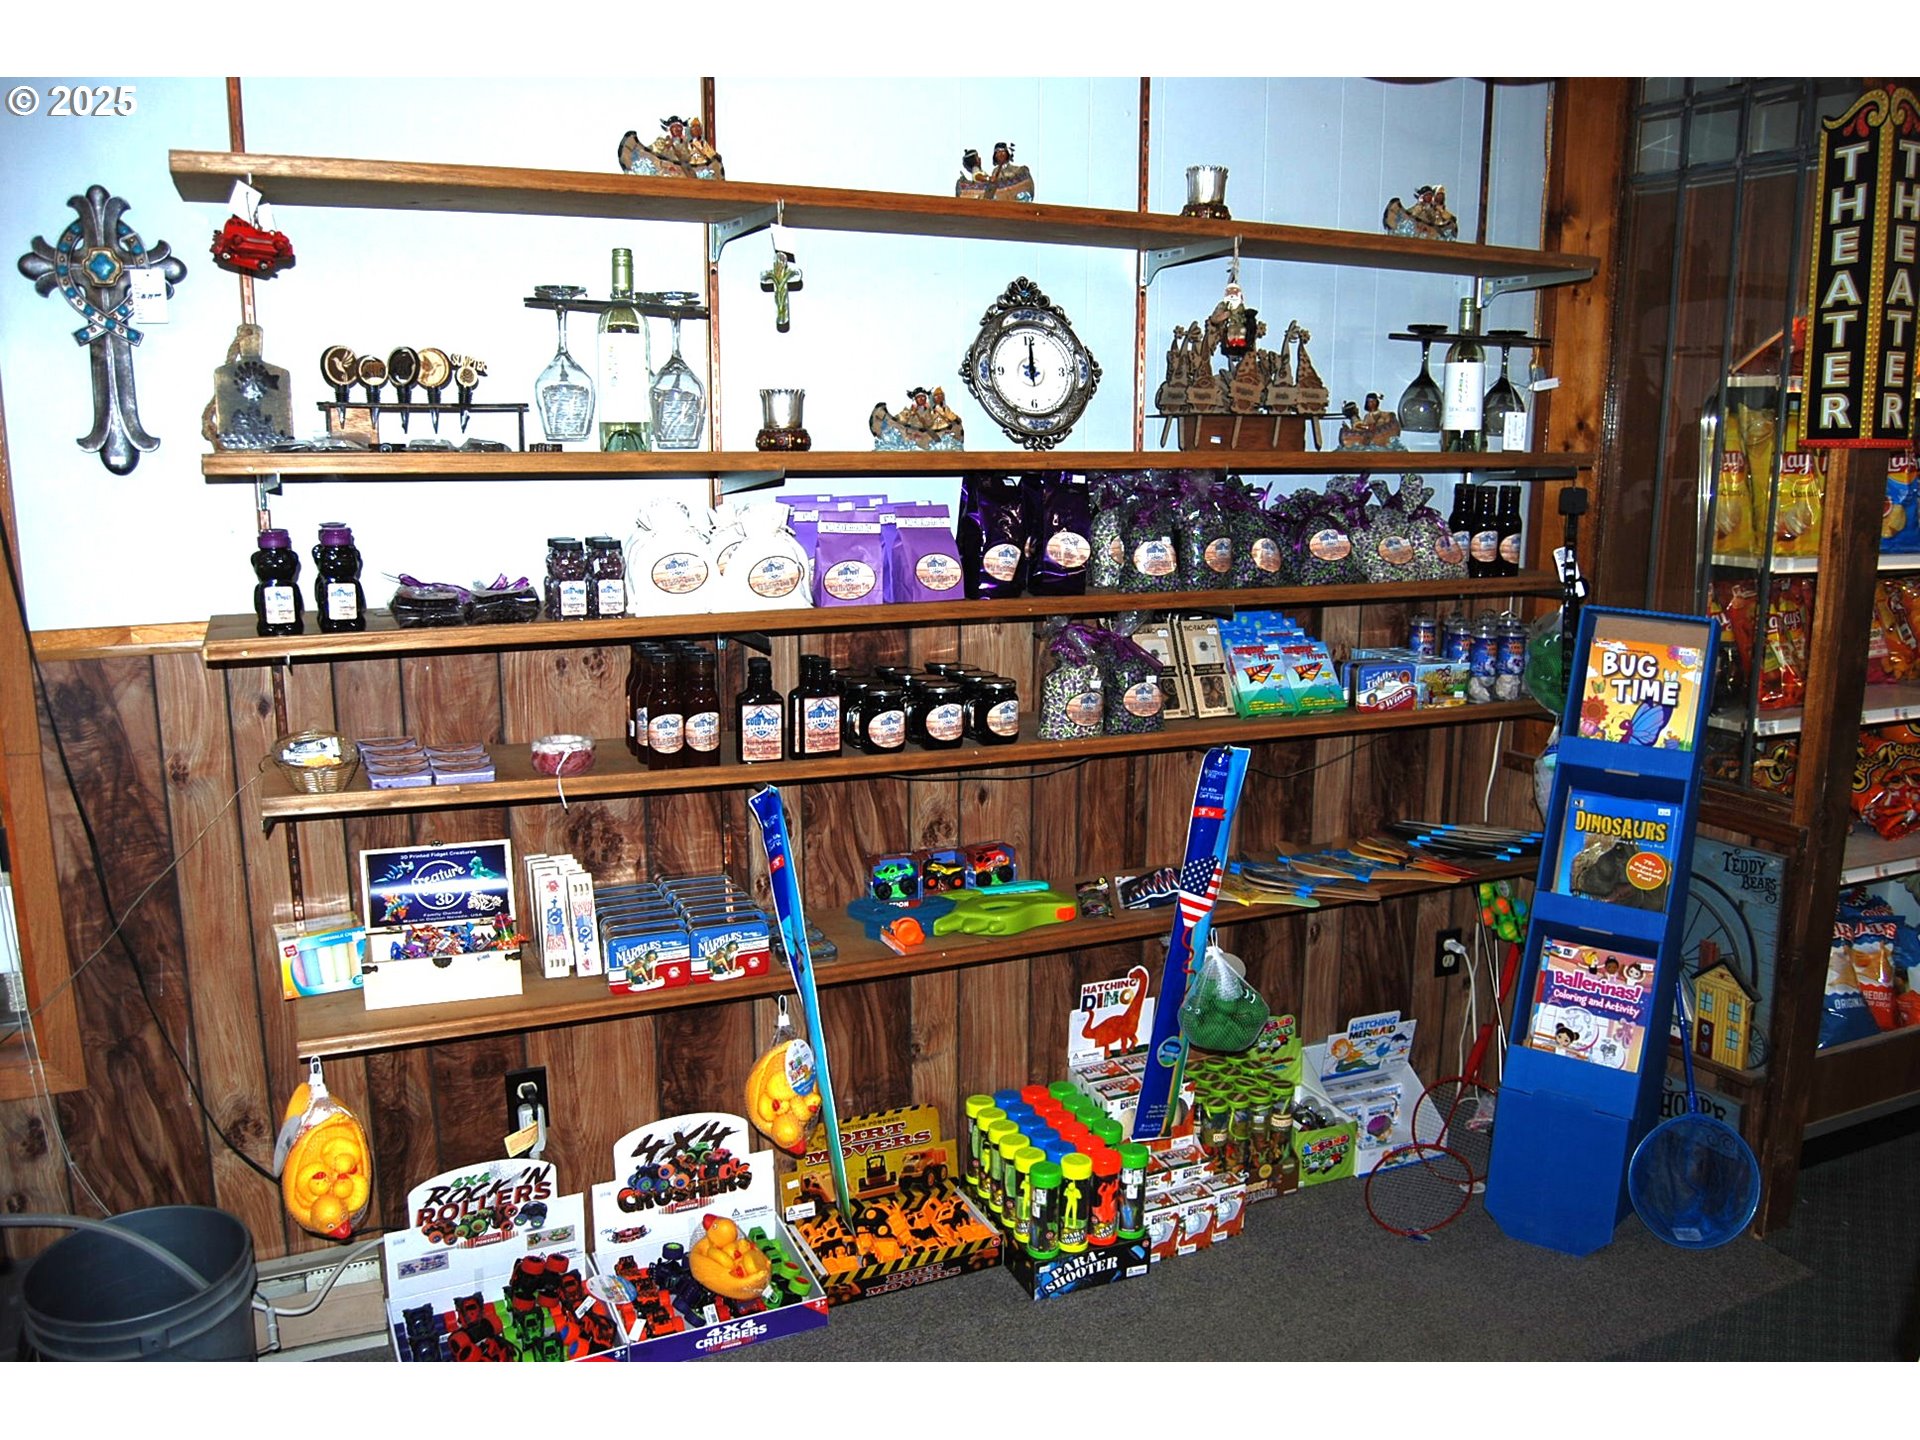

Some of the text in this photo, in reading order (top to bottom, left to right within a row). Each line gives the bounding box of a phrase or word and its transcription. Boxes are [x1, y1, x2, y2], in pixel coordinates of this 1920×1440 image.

[1820, 141, 1870, 429] THEATER
[1881, 140, 1920, 428] THEATER
[1602, 651, 1658, 678] BUG
[1611, 678, 1679, 707] TIME
[1575, 810, 1668, 842] DINOSAURS
[435, 893, 454, 906] 3D
[616, 940, 662, 966] MARBLES
[698, 931, 743, 957] MARBLES
[1082, 978, 1139, 994] HATCHING
[1554, 971, 1643, 1002] Ballerinas!
[1081, 988, 1136, 1012] DINO
[1553, 988, 1640, 1017] Coloring and Activity
[1349, 1025, 1396, 1040] MERMAID
[1350, 1016, 1399, 1032] HATCHING
[840, 1122, 906, 1145] DIRT
[416, 1181, 552, 1227] ROLLERS
[886, 1263, 944, 1284] DIRT
[1045, 1256, 1118, 1295] SHOOTER
[1051, 1250, 1106, 1280] PARA-
[866, 1265, 961, 1297] MOVERS
[815, 1300, 826, 1309] 3+
[695, 1324, 767, 1349] CRUSHERS
[615, 1349, 626, 1358] 3+
